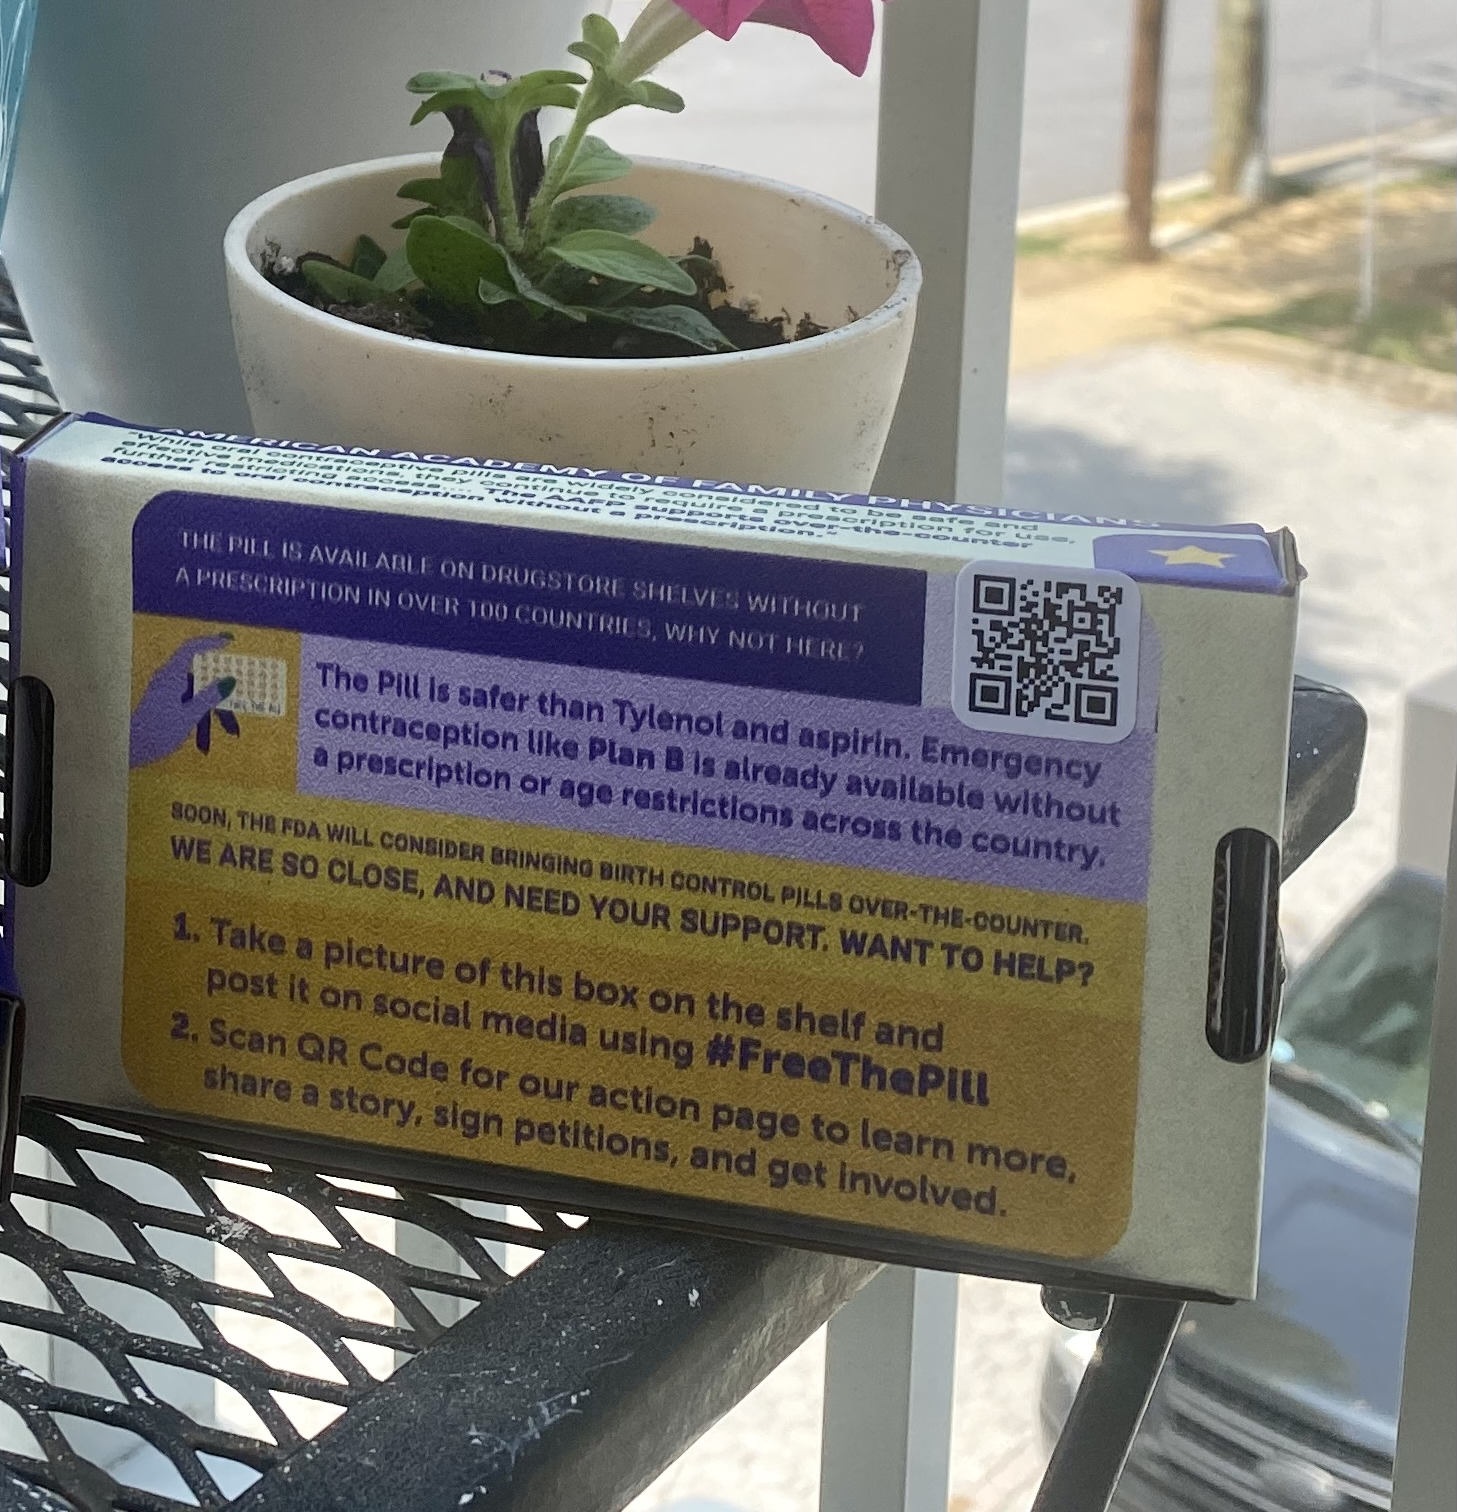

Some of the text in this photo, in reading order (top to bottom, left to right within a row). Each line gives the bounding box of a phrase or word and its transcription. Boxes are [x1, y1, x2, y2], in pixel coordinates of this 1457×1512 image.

[157, 428, 1163, 528] AMERICAN ACADEMY OF FAMILY PHYSICIANS
[181, 531, 864, 623] THE PILL IS AVAILABLE ON DRUGSTORE SHELVES WITHOUT
[314, 708, 1120, 826] contraception like Plan B is already available without
[315, 661, 1101, 785] The Pill is safer than Tylenol and aspirin. Emergency
[170, 802, 1089, 944] SOON, THE FDA WILL CONSIDER BRINGING BIRTH CONTROL PILLS OVER-THE-COUNTER.
[170, 835, 1094, 987] WE ARE SO CLOSE, AND NEED YOUR SUPPORT. WANT TO HELP?
[173, 911, 944, 1053] 1. Take a picture of this box on the shelf and
[207, 966, 989, 1106] post it on social media using #FreeThePill
[169, 1011, 1076, 1186] 2. Scan QR Code for our action page to learn more,
[203, 1065, 1008, 1216] share a story, sign petitions, and get involved.
